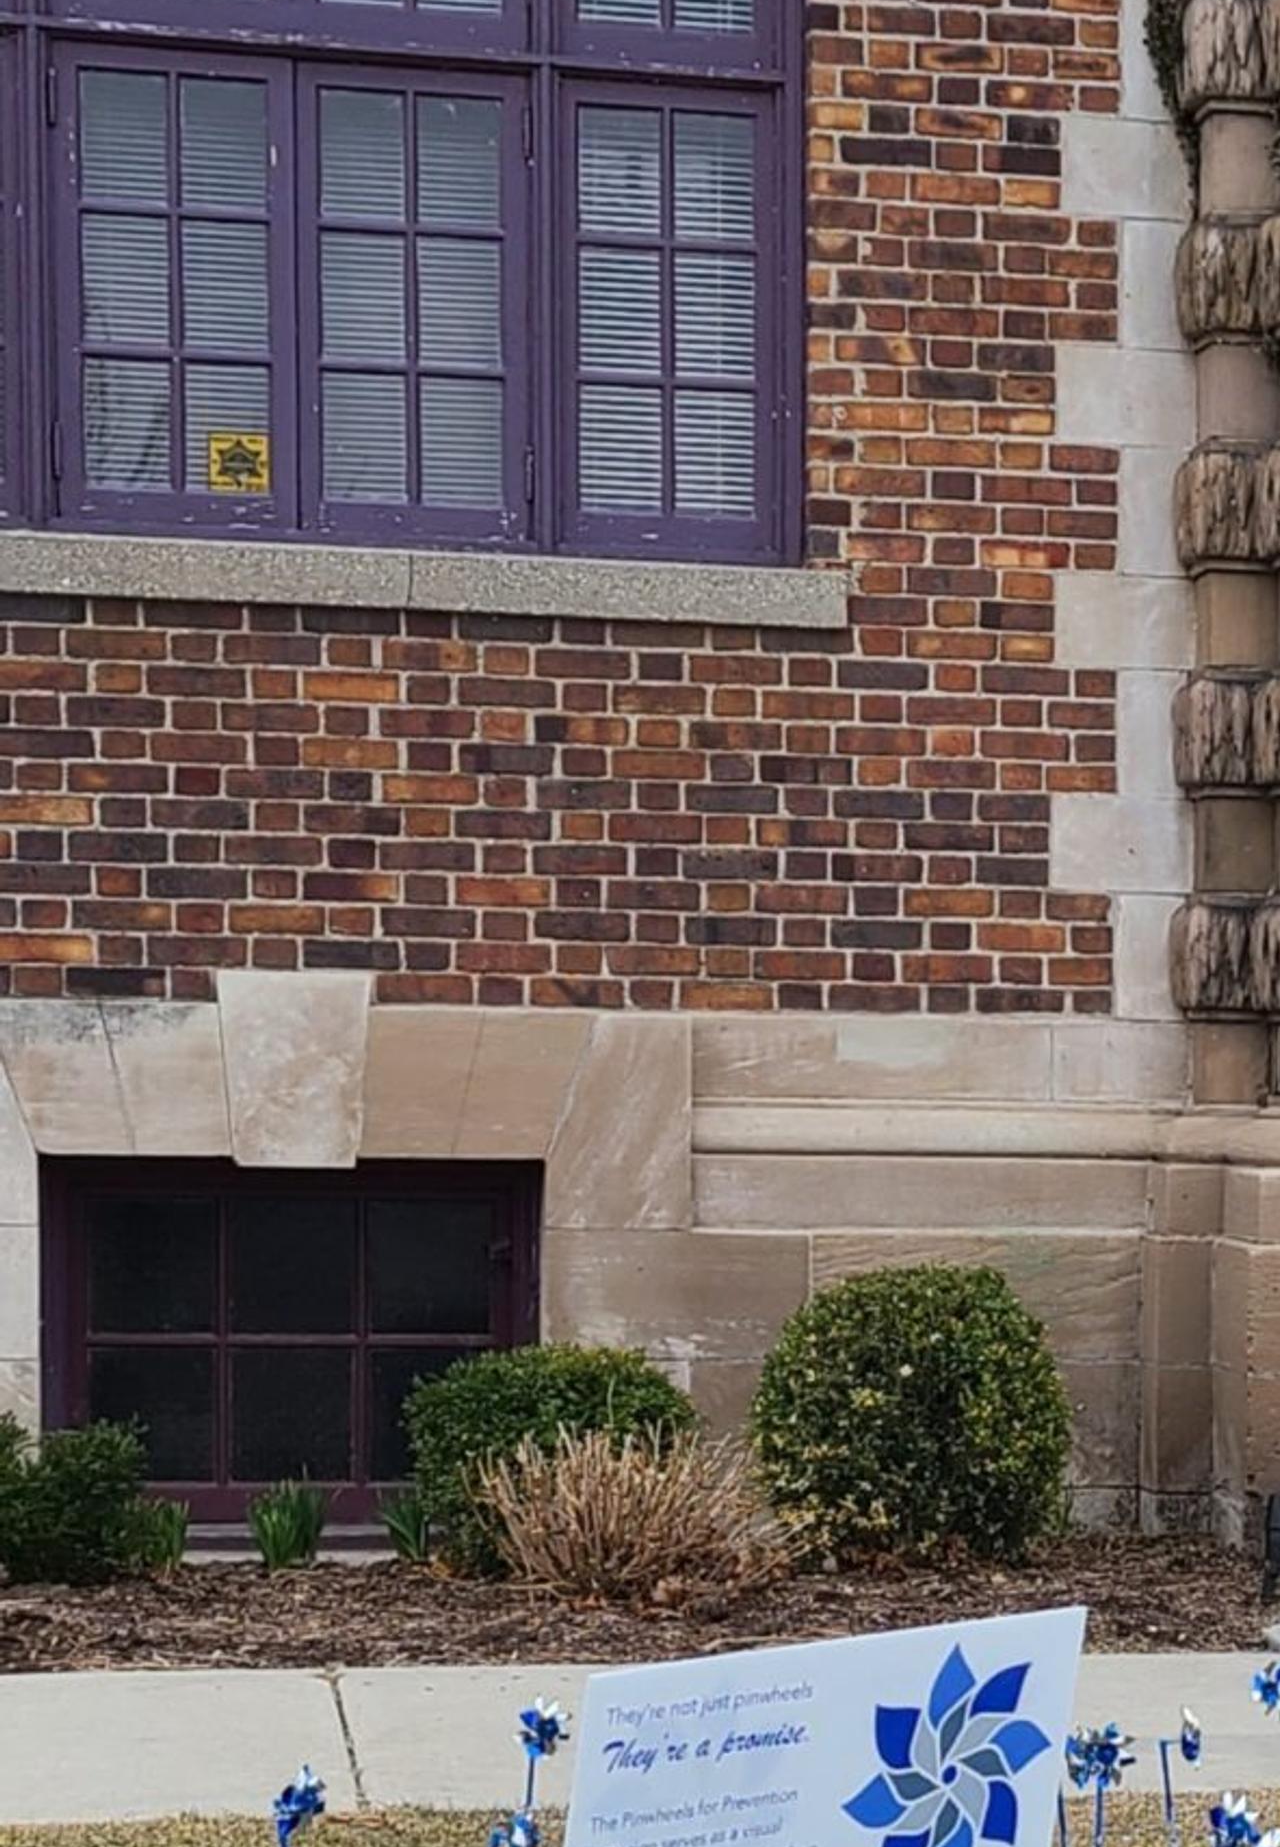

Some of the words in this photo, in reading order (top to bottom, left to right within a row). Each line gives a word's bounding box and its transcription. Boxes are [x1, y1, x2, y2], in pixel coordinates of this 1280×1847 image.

[606, 1704, 667, 1729] They're
[669, 1699, 698, 1717] not
[698, 1694, 731, 1718] just
[732, 1682, 814, 1712] pinwheels
[602, 1731, 688, 1774] They're
[694, 1739, 711, 1758] a
[590, 1815, 619, 1835] The
[621, 1805, 695, 1830] Pinwheels
[698, 1799, 720, 1817] for
[721, 1789, 799, 1813] Prevention
[709, 1829, 727, 1845] as
[730, 1827, 739, 1843] a
[742, 1816, 784, 1840] visual
